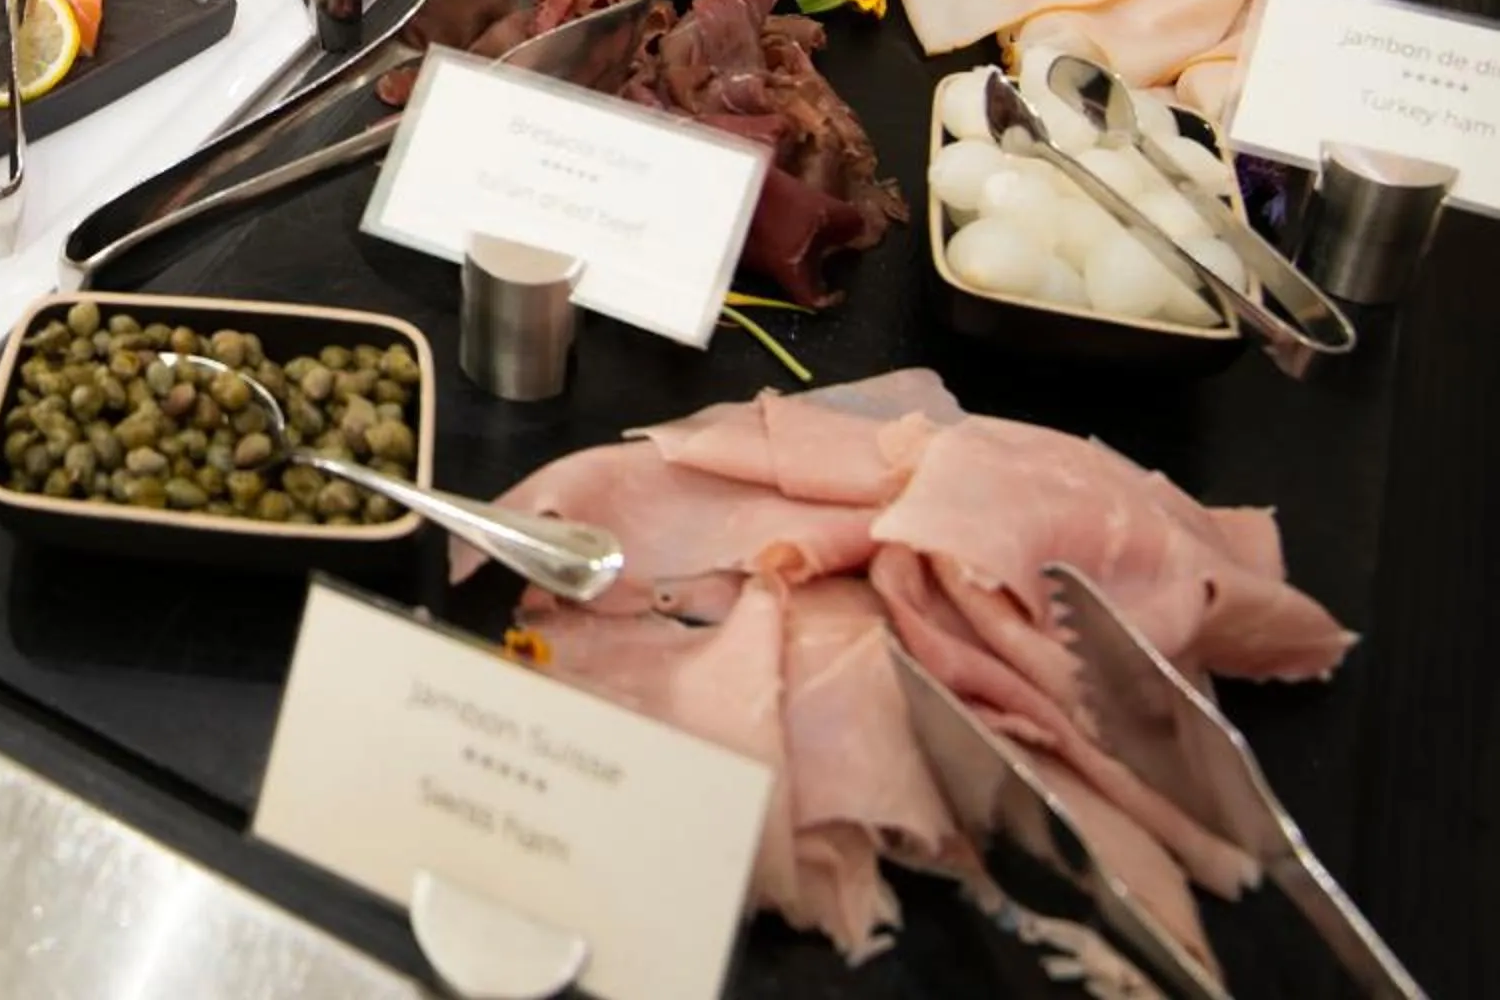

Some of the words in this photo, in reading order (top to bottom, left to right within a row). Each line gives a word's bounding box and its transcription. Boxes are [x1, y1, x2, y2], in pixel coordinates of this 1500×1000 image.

[1438, 50, 1468, 70] de
[1361, 88, 1438, 127] Turkey
[1444, 109, 1497, 138] ham
